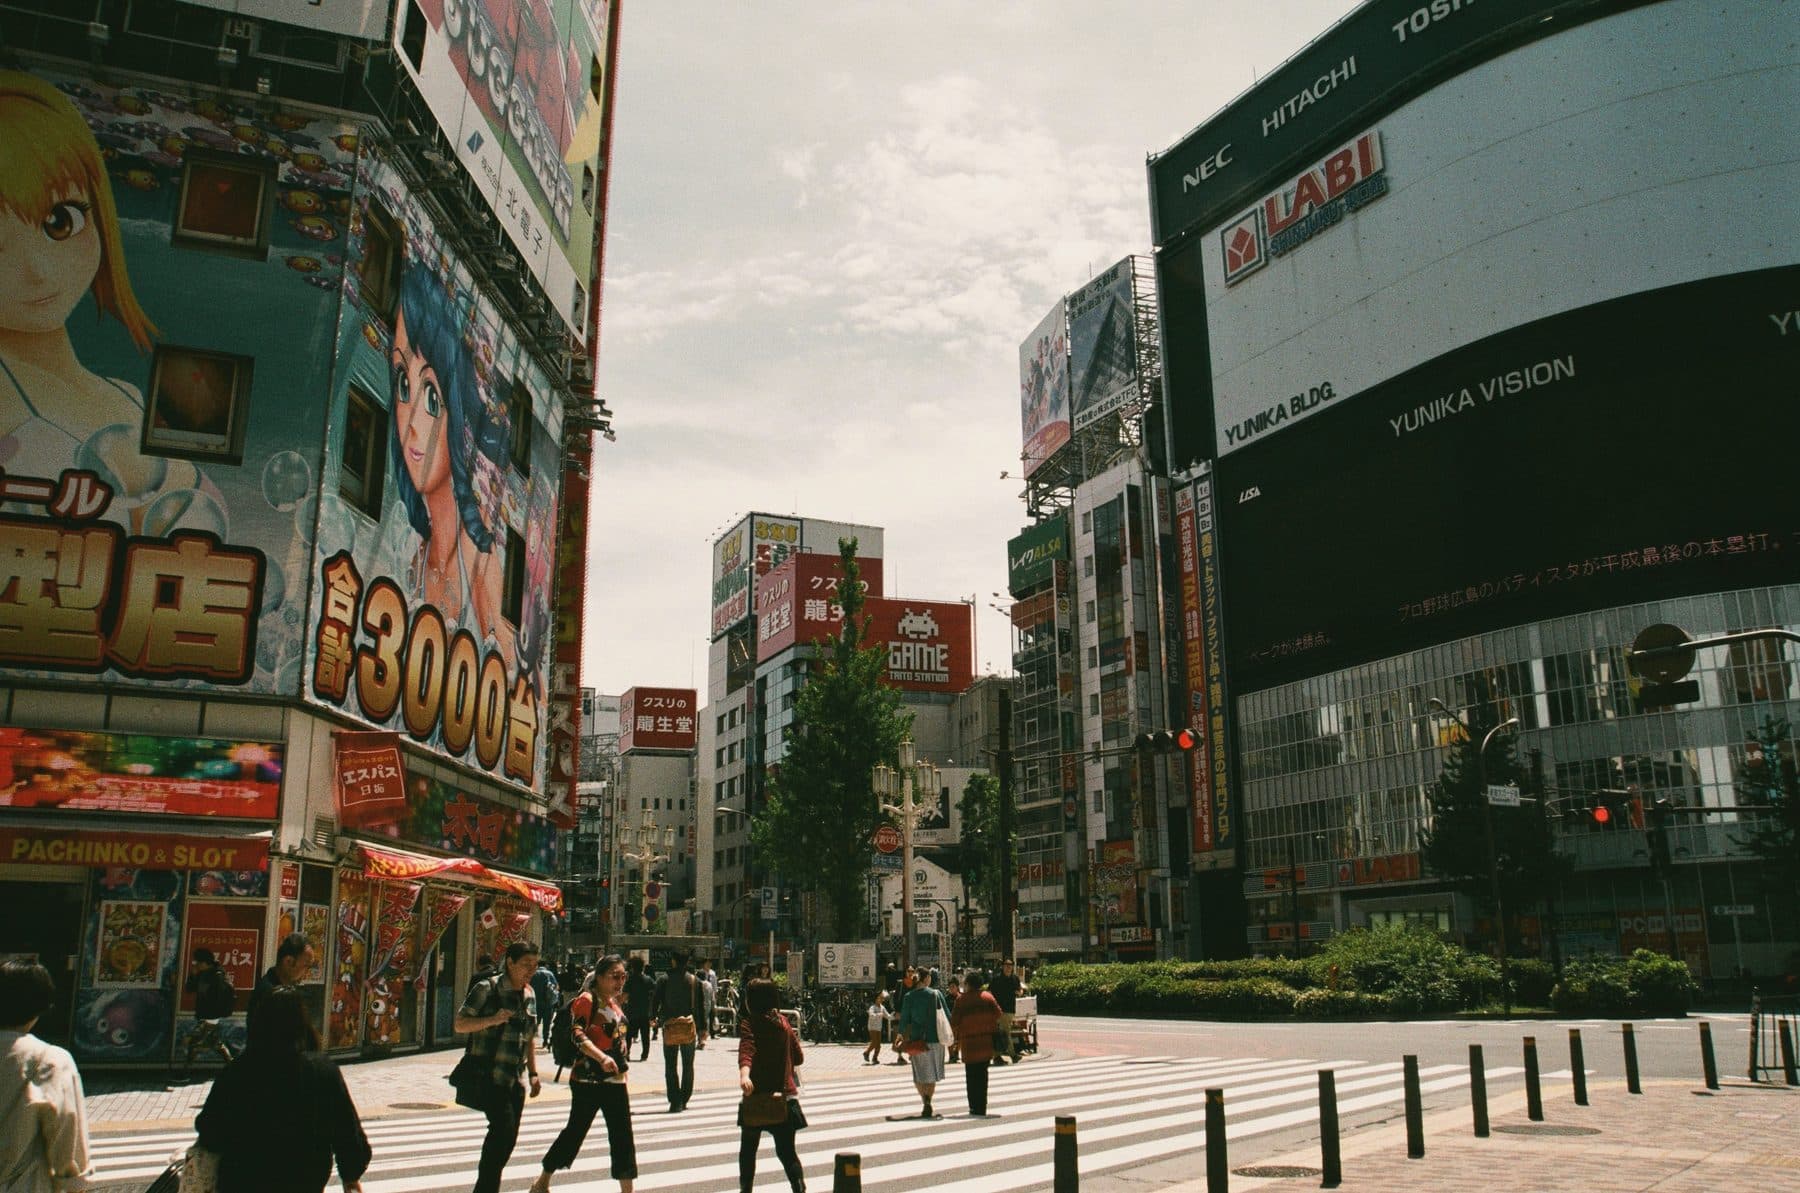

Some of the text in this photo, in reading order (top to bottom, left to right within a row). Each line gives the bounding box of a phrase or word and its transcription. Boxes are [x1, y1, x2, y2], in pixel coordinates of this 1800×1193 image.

[1262, 56, 1357, 137] HITACHI
[1183, 144, 1232, 193] NEC
[1264, 134, 1376, 238] LABI
[1225, 381, 1336, 446] YUNIKA BLDG.
[1390, 355, 1575, 437] YUNIKA VISION
[319, 556, 362, 702] 合計
[358, 580, 541, 780] 3000台
[889, 641, 949, 671] GAME
[889, 670, 949, 683] TAITO STATION
[643, 697, 687, 709] クスリの
[343, 764, 398, 785] エスパス
[11, 838, 238, 868] PACHINKO & SLOT
